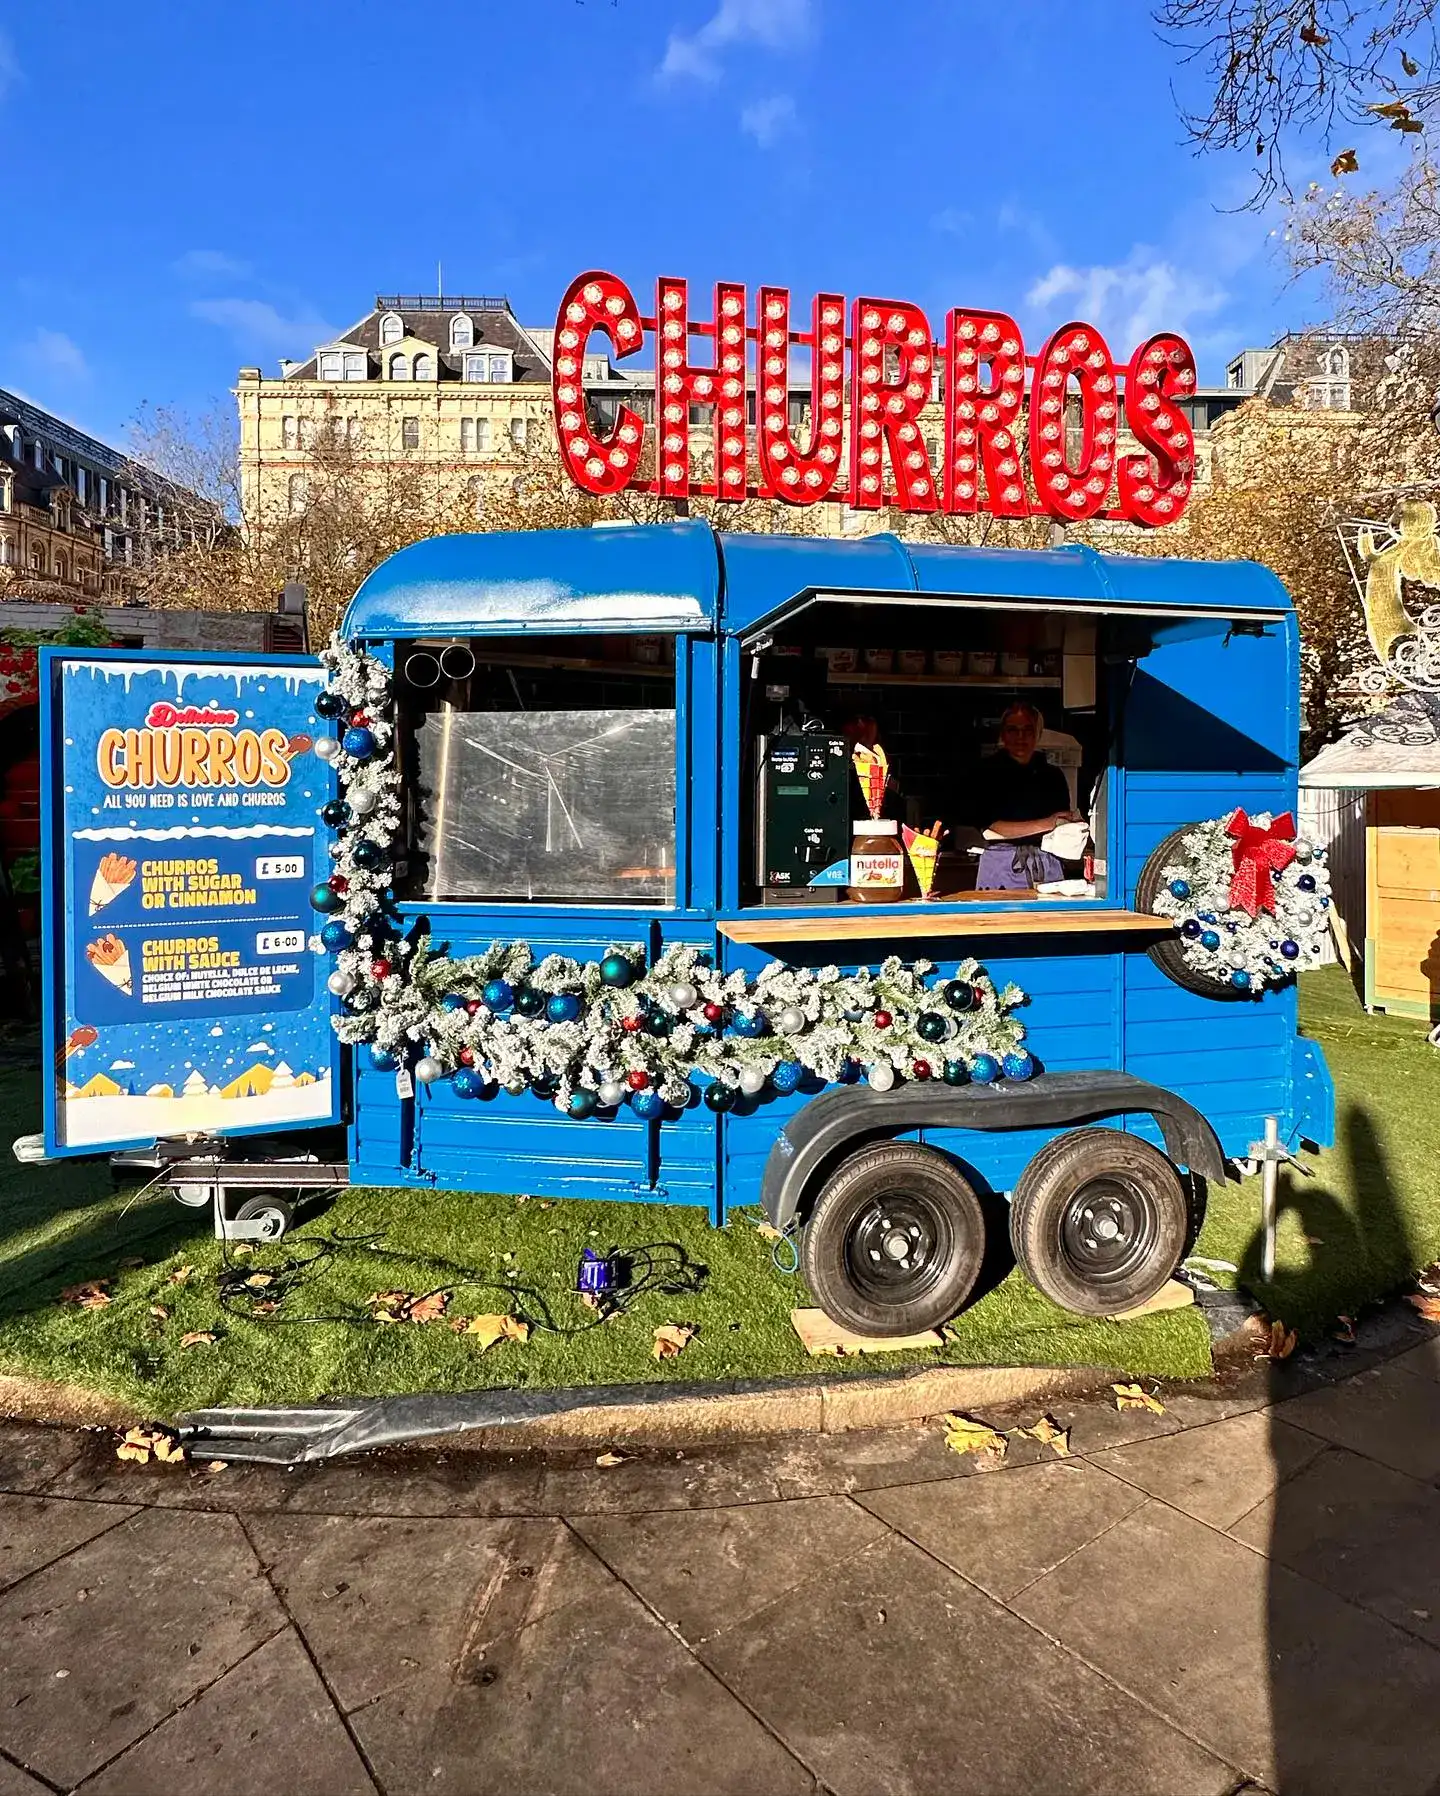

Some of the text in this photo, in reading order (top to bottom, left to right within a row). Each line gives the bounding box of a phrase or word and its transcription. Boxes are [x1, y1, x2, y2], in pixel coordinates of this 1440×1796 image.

[552, 270, 1198, 528] CHURROS
[149, 702, 238, 728] Delicious
[99, 729, 290, 787] CHURROS
[103, 792, 286, 809] ALL YOU NEED IS LOVE AND CHURROS
[142, 859, 218, 876] CHURROS
[262, 862, 269, 874] £
[857, 857, 899, 870] nutella
[142, 874, 242, 893] WITH SUGAR
[142, 889, 256, 909] OR CINNAMON
[142, 937, 219, 955] CHURROS
[262, 937, 269, 950] £
[142, 952, 240, 972] WITH SAUCE
[142, 974, 174, 984] CHOICE
[190, 969, 230, 980] NUTELLA,
[232, 966, 259, 977] DULCE
[259, 965, 271, 976] DE
[272, 964, 300, 975] LECHE,
[182, 979, 211, 990] WHITE
[211, 976, 260, 989] CHOCOLATE
[260, 975, 273, 985] OR
[182, 990, 205, 1001] MILK
[205, 986, 254, 999] CHOCOLATE
[254, 984, 281, 995] SAUCE
